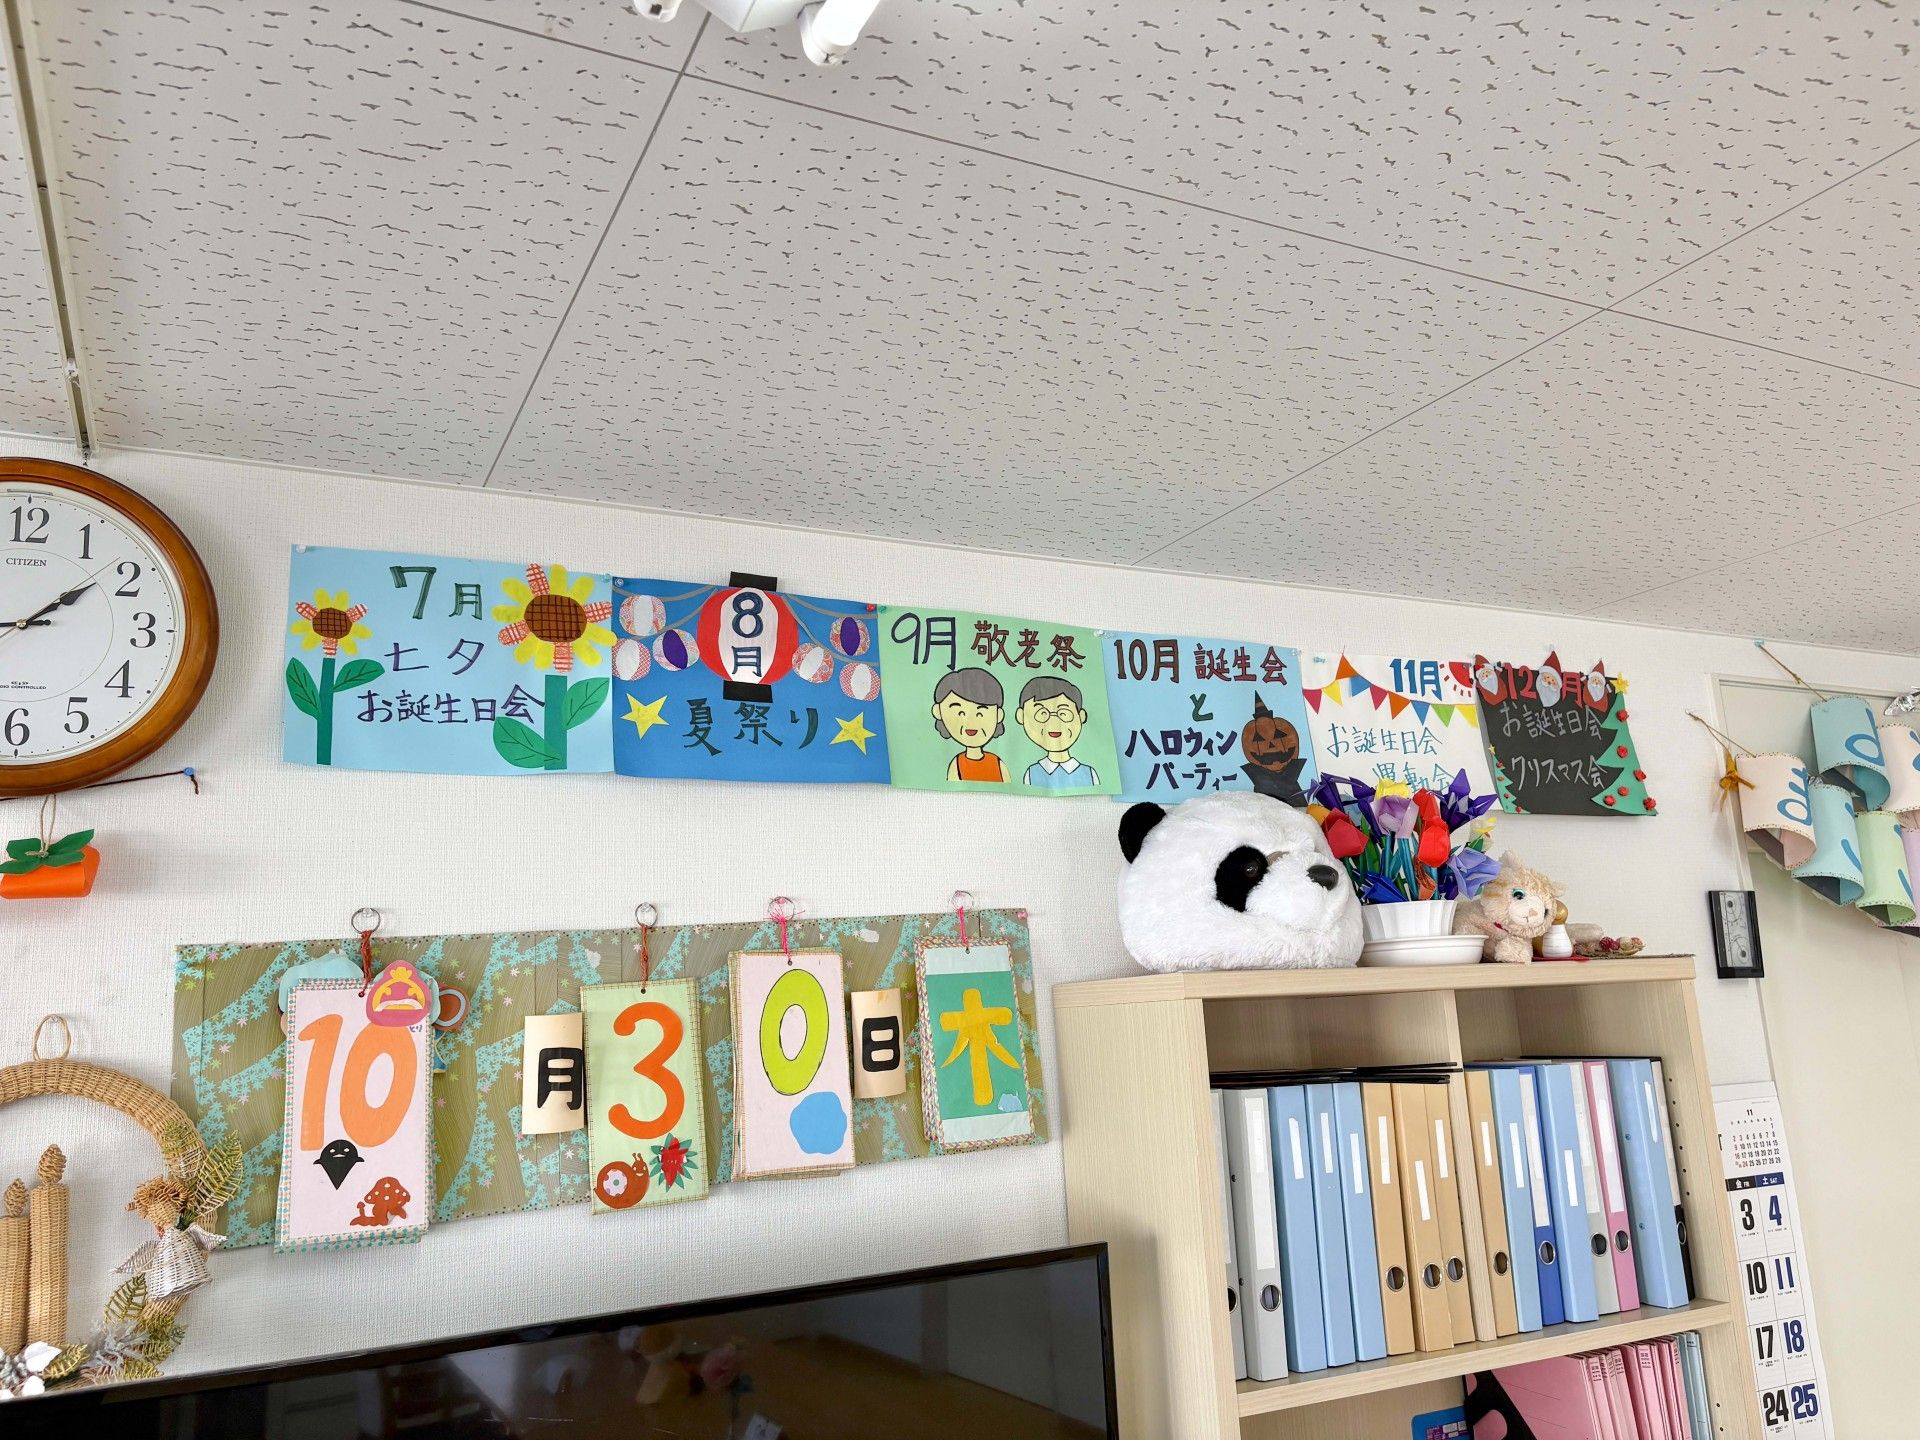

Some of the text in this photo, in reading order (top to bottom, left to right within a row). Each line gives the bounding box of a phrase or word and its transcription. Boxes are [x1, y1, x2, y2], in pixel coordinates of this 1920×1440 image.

[9, 505, 50, 543] 12
[78, 523, 94, 560] 1
[6, 557, 47, 567] CITIZEN
[115, 561, 142, 597] 2
[389, 565, 483, 620] 7月
[129, 611, 156, 648] 3
[731, 591, 764, 678] 8月
[891, 612, 1086, 672] 9月 敬老祭
[384, 638, 484, 675] 七夕
[1113, 638, 1288, 686] 10月 誕生会
[104, 659, 135, 698] 4
[1389, 658, 1442, 701] 11月
[1503, 662, 1584, 709] 12月
[64, 696, 90, 734] 5
[357, 684, 546, 724] お誕生日会
[1189, 693, 1213, 722] と
[1500, 701, 1602, 740] お誕生日会
[4, 708, 30, 746] 6
[682, 697, 819, 756] 夏祭り
[1124, 727, 1238, 758] ハロウィン
[1327, 722, 1443, 758] お誕生日会
[1146, 762, 1238, 790] パーティー
[1511, 755, 1608, 791] クリスマス会
[298, 969, 1021, 1151] 10 月 3 0 日 木
[1762, 1176, 1769, 1185] 土
[1740, 1194, 1782, 1231] 3 4
[1746, 1256, 1795, 1295] 10 11
[1755, 1319, 1805, 1360] 17 18
[1762, 1383, 1819, 1427] 24 25
